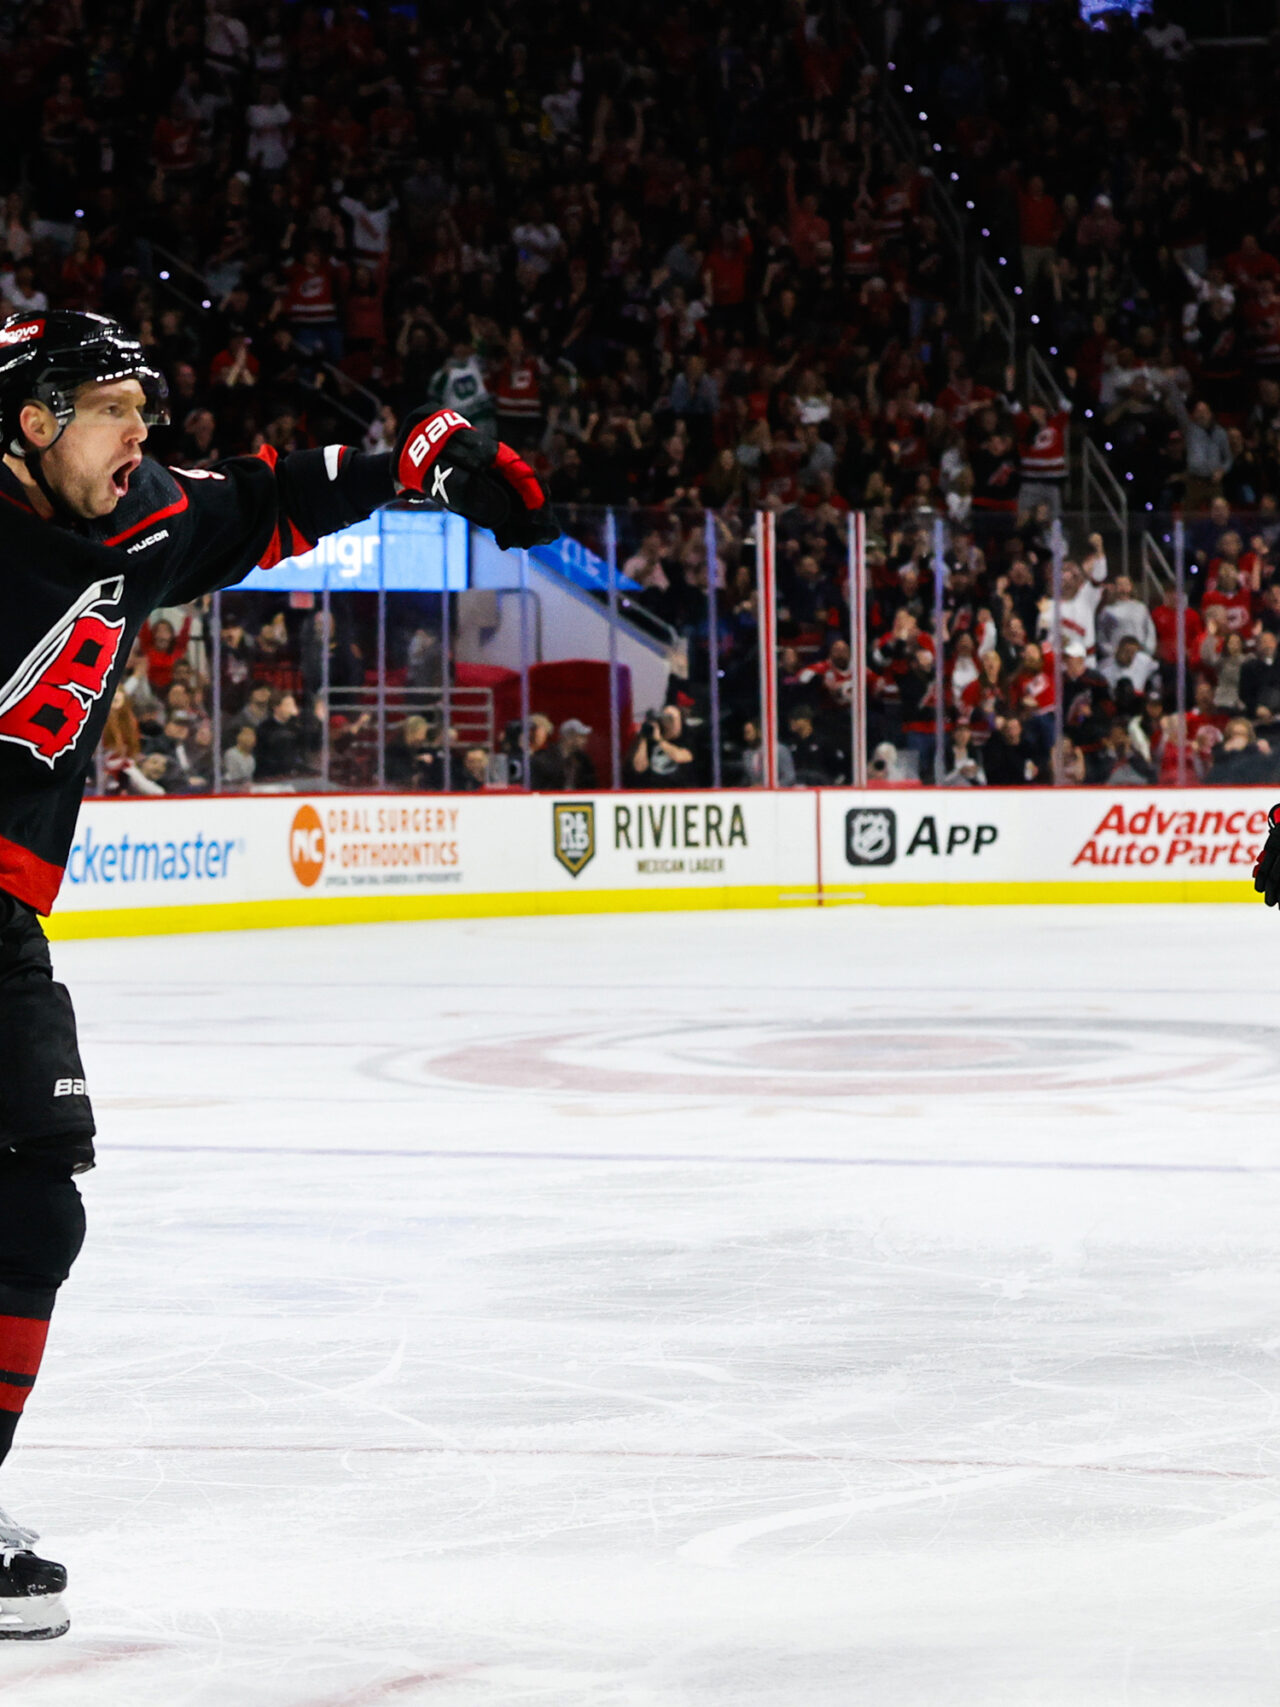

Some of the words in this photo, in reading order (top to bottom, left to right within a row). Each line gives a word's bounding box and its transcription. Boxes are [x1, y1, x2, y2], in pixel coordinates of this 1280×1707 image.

[126, 529, 170, 555] NUCOR
[328, 809, 370, 834] ORAL
[378, 808, 459, 834] SURGERY
[614, 804, 747, 849] RIVIERA
[1094, 803, 1268, 836] Advance
[342, 841, 459, 869] ORTHODONTICS
[1072, 840, 1160, 866] Auto
[1165, 839, 1259, 866] Parts
